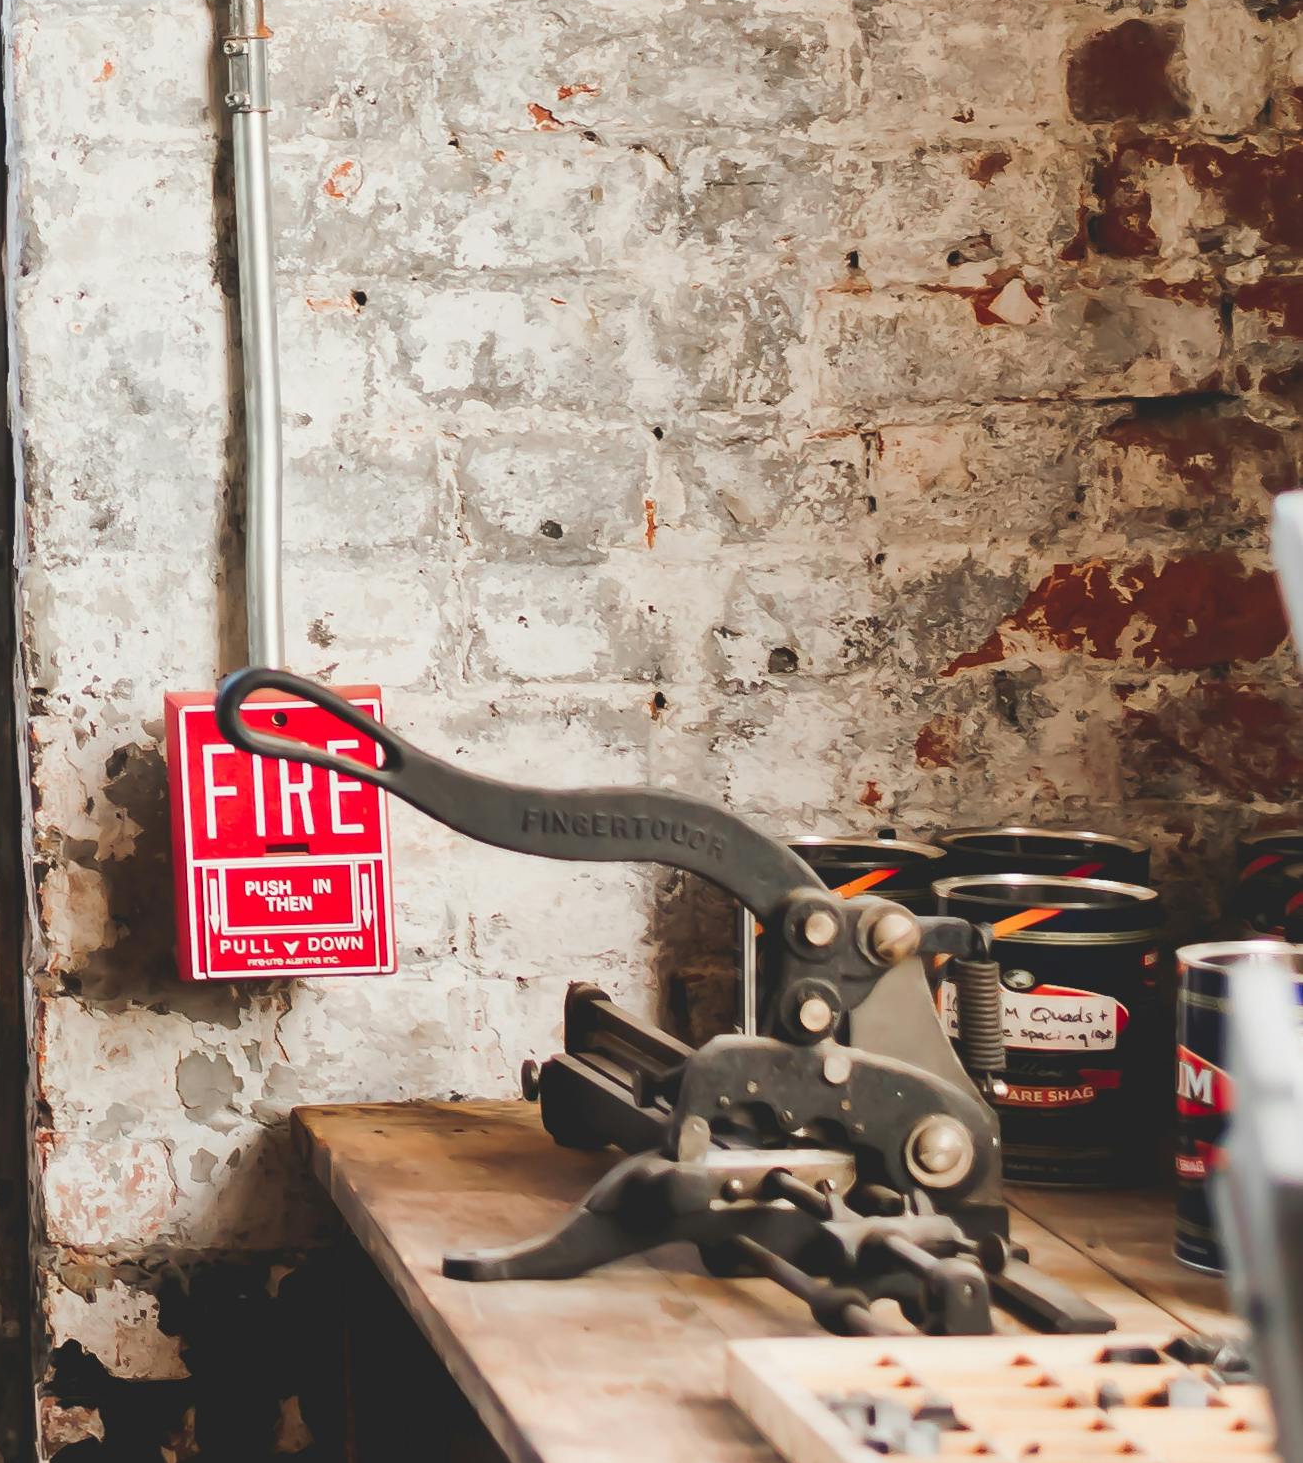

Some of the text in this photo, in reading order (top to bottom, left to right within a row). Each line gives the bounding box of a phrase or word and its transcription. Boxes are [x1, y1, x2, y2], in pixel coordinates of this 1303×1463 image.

[202, 739, 365, 840] FIRE
[521, 808, 728, 860] FINGERTOUCH
[245, 878, 332, 896] PUSH IN
[265, 895, 313, 912] THEN
[219, 936, 364, 954] PULL DOWN
[1030, 1006, 1093, 1024] Quads
[1048, 1087, 1094, 1102] SHAG
